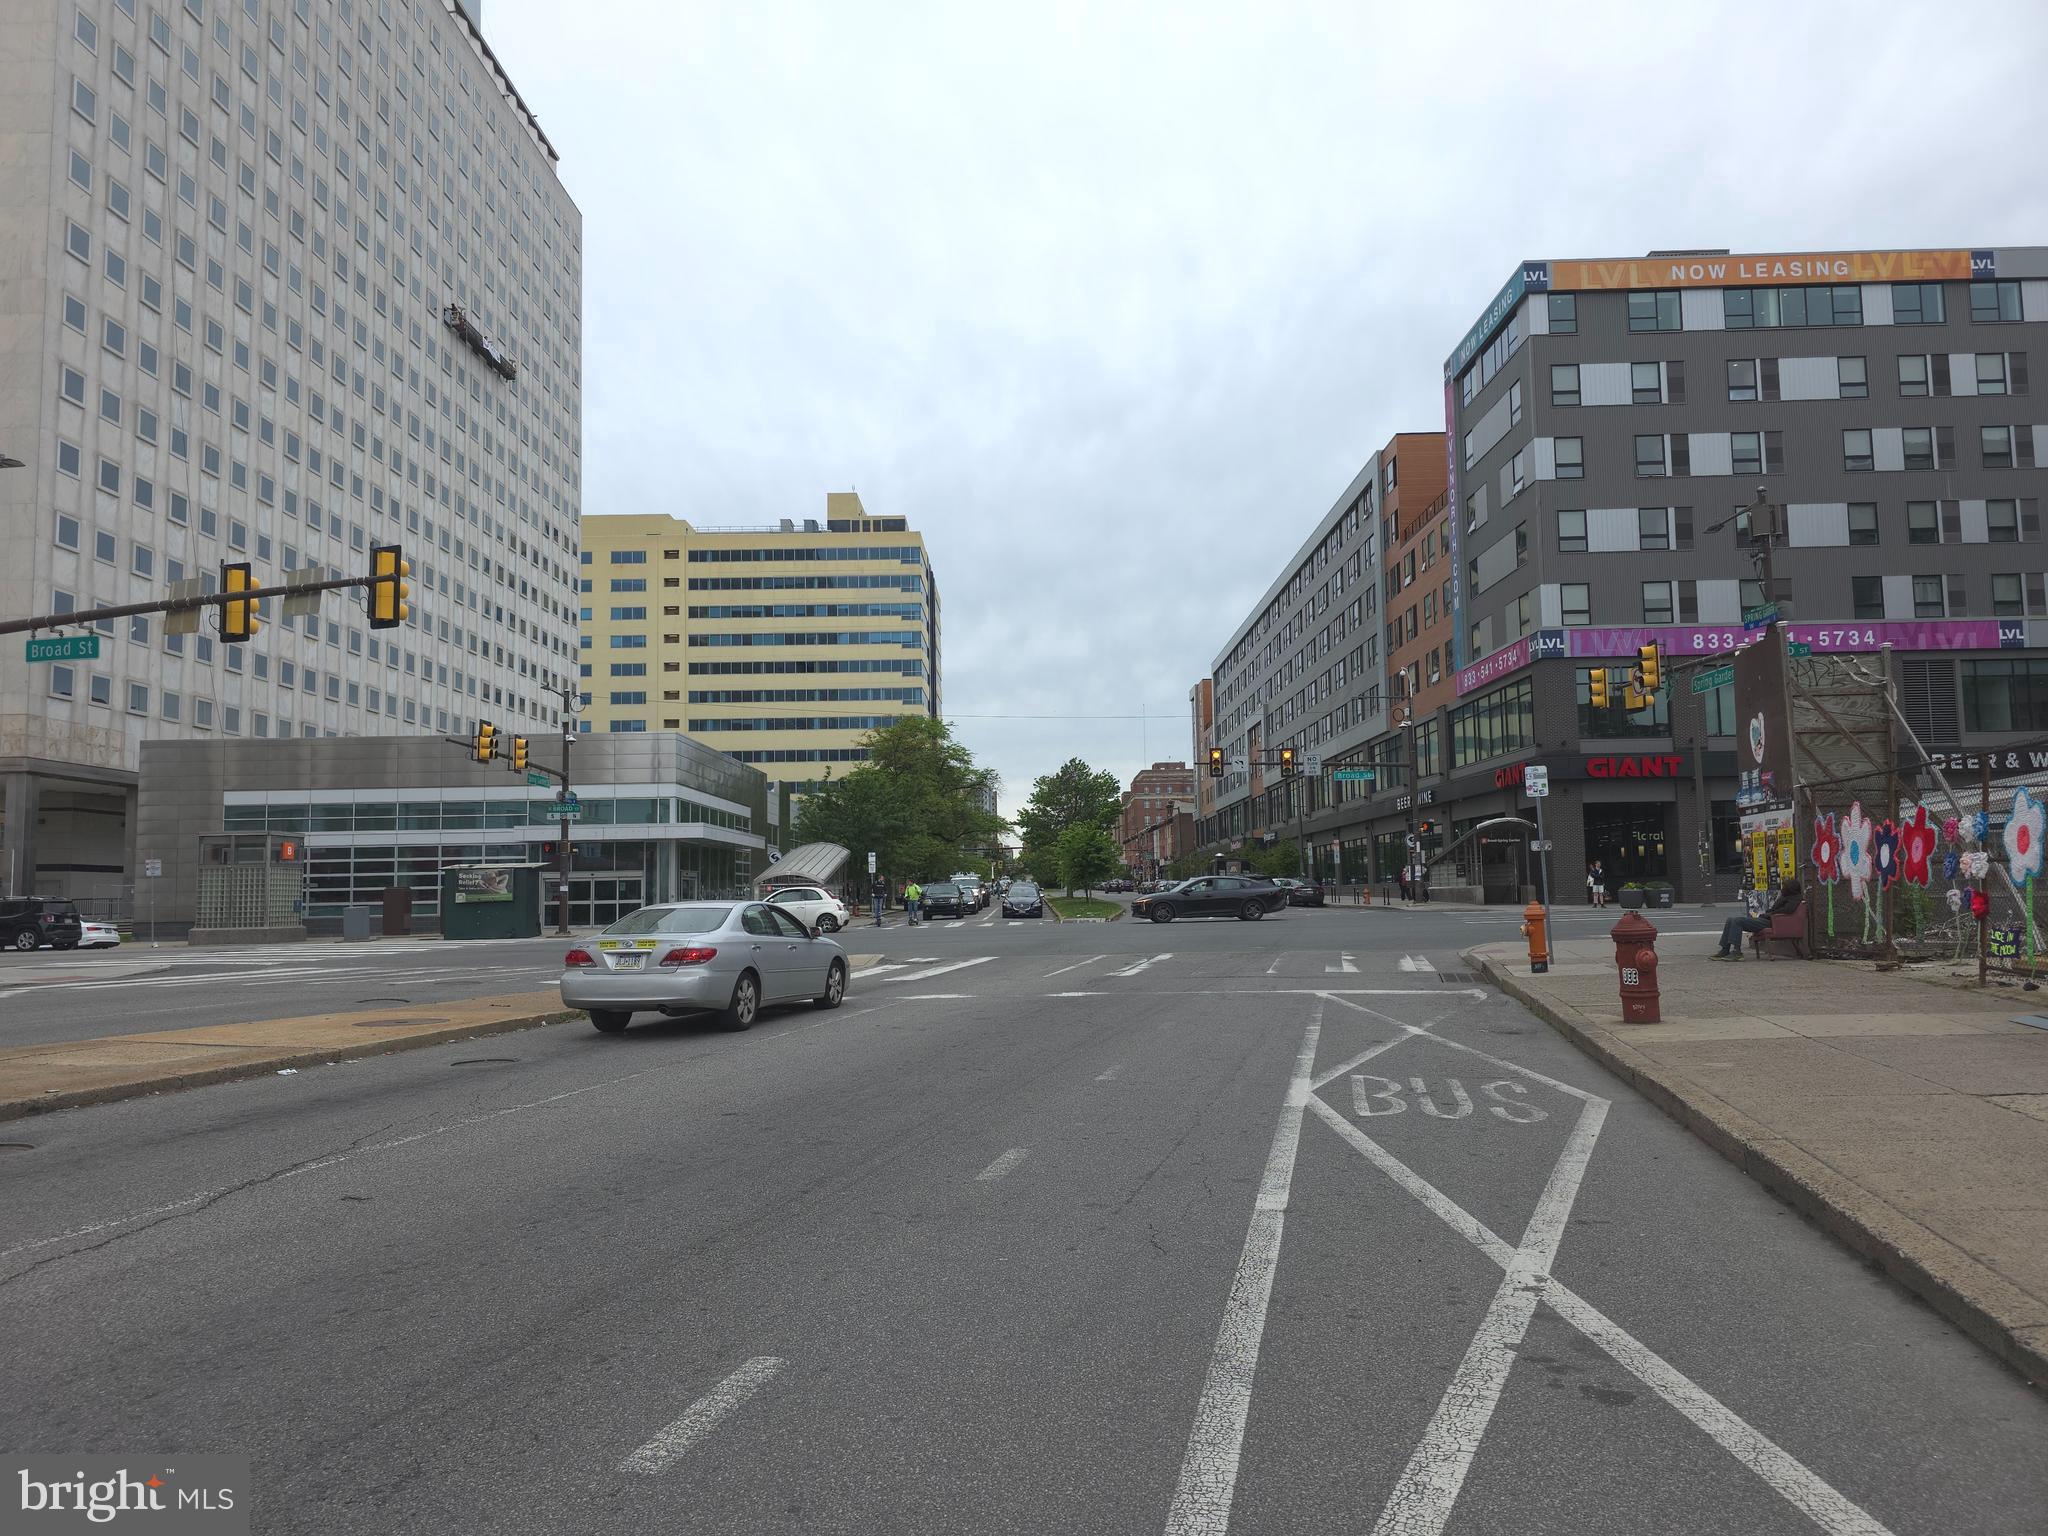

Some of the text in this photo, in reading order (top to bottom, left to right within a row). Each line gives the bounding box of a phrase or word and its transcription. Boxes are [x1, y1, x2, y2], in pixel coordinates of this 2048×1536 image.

[1671, 260, 1849, 280] NOW LEASING
[1971, 259, 1995, 270] LVL
[1523, 271, 1548, 282] LVL
[1459, 288, 1514, 363] NOW LEASING
[1819, 630, 1875, 647] 5734
[1999, 629, 2025, 640] LVL
[31, 640, 93, 658] Broad St
[1539, 638, 1565, 649] LVL
[1694, 677, 1713, 691] Spring
[1585, 755, 1685, 778] GIANT
[2005, 752, 2020, 769] &
[1397, 796, 1411, 810] BEER
[1351, 1074, 1549, 1123] BUS
